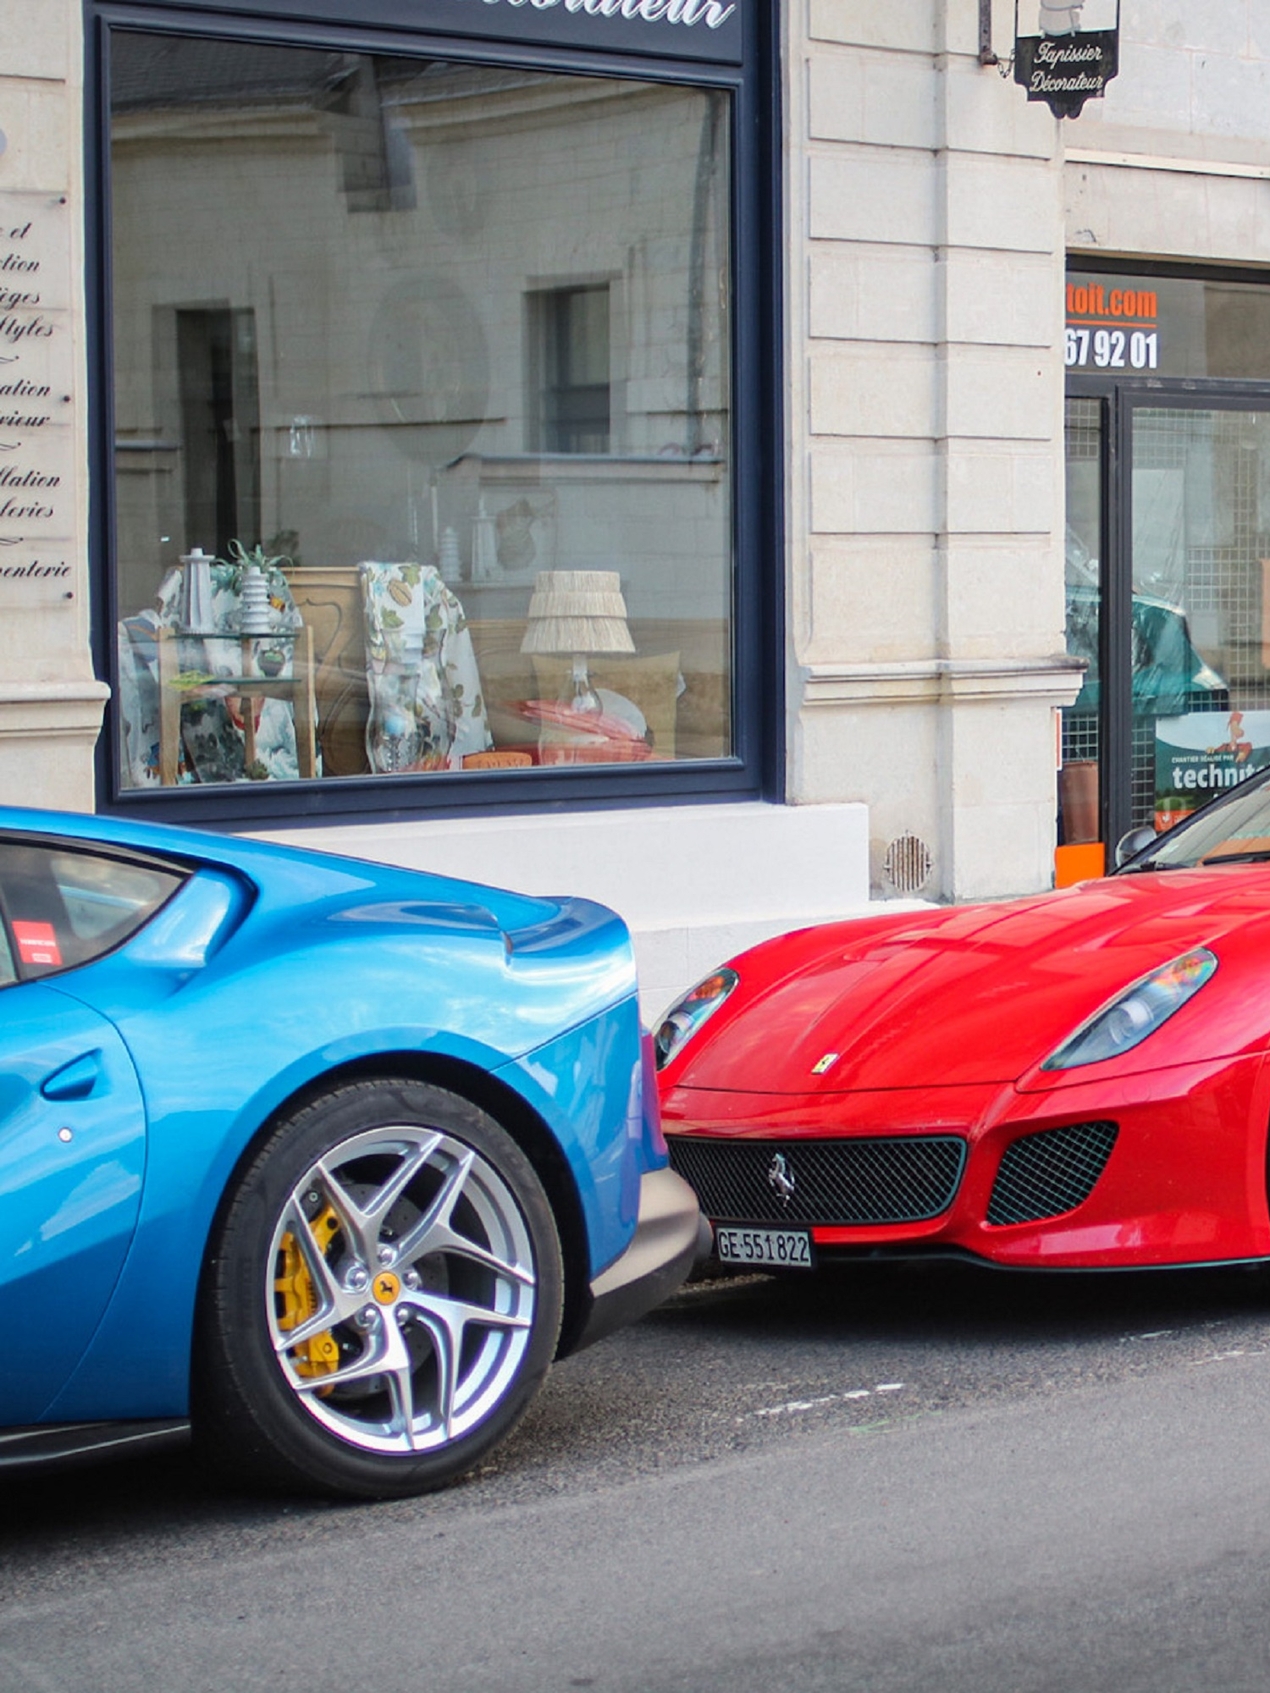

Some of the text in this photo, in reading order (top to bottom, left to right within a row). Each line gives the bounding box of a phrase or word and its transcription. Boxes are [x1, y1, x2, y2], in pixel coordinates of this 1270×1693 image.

[1034, 42, 1102, 69] Tapissier
[1029, 70, 1104, 92] Décorateur
[0, 253, 40, 271] tion
[1064, 328, 1157, 369] 67 92 01
[0, 560, 71, 578] enterie
